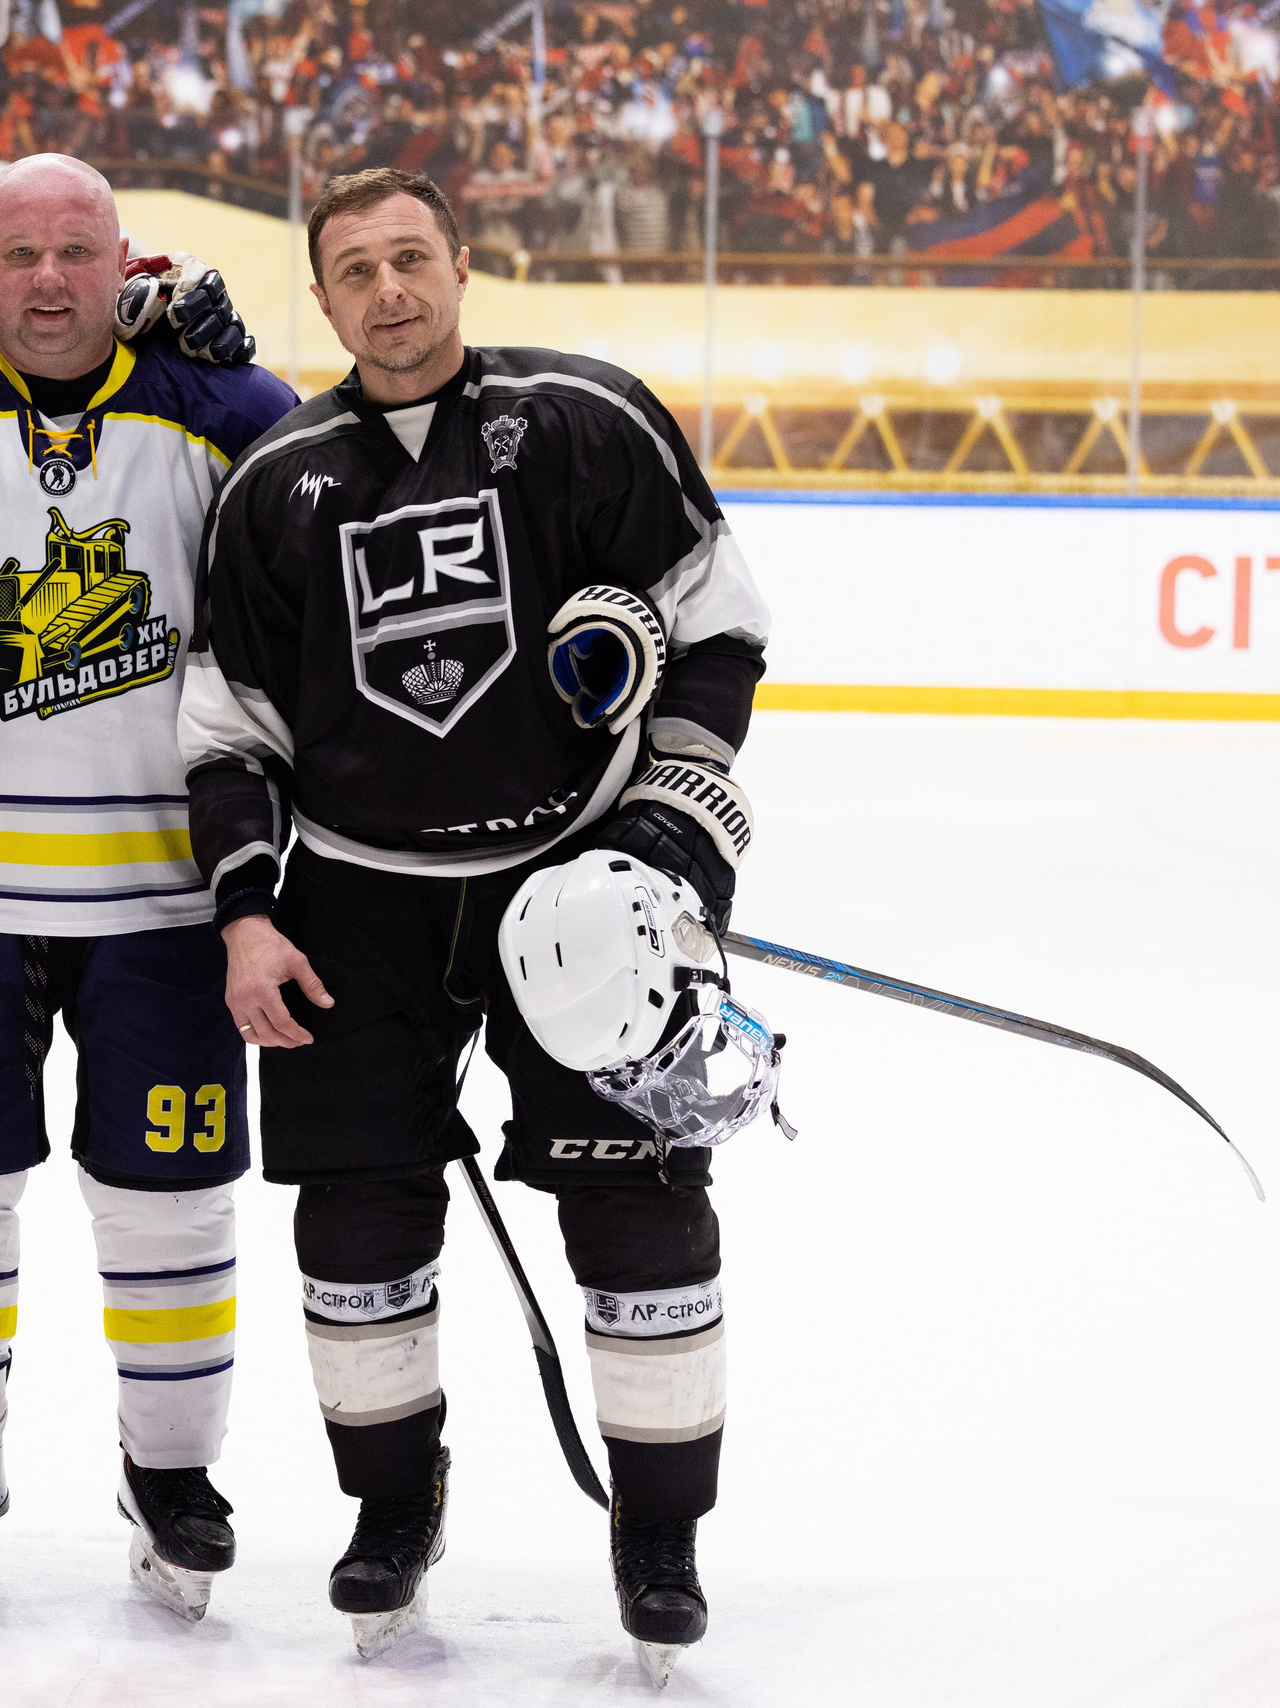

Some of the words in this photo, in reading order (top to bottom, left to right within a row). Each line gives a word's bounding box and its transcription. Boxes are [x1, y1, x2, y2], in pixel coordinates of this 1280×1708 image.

[355, 516, 496, 615] LR
[136, 619, 165, 645] ХК
[1158, 554, 1280, 650] CI
[3, 642, 166, 715] БУЛЬДОЗЕР
[761, 953, 822, 977] NEXUS
[145, 1085, 226, 1153] 93
